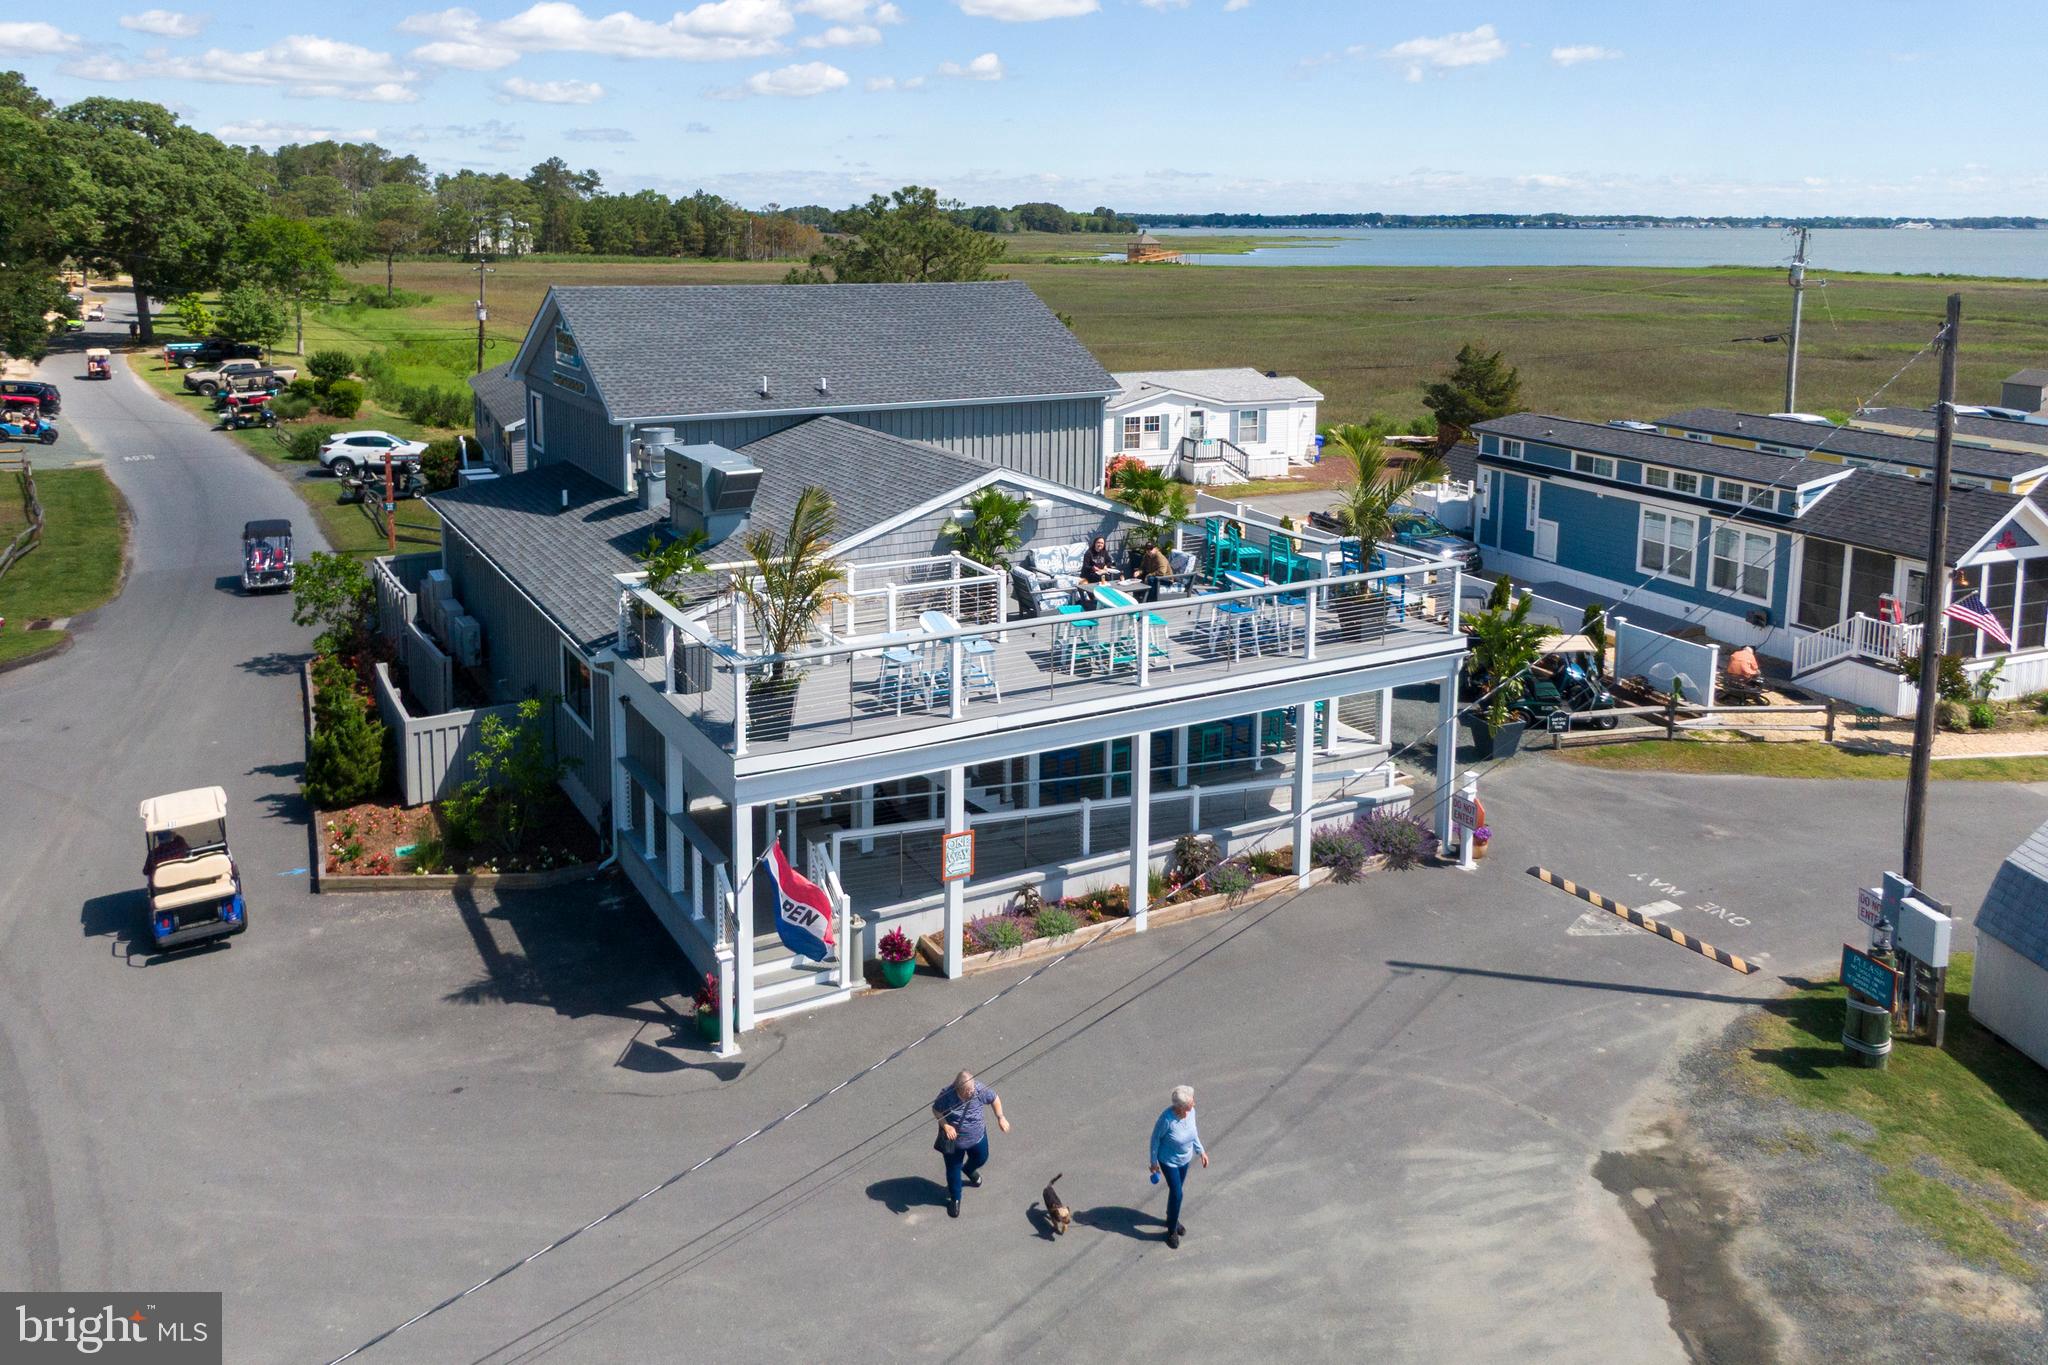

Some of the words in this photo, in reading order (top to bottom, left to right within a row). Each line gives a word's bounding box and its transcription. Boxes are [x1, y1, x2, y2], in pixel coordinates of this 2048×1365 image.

[1453, 799, 1462, 809] DO
[1463, 802, 1476, 816] NOT
[1454, 811, 1475, 827] ENTER
[948, 836, 970, 850] ONE
[947, 848, 969, 864] WAY
[1628, 872, 1688, 897] WAY
[1860, 894, 1870, 907] DO
[783, 900, 820, 927] PEN
[1696, 902, 1751, 927] ONE
[1860, 908, 1880, 923] ENTE
[1853, 954, 1884, 979] PLEASE
